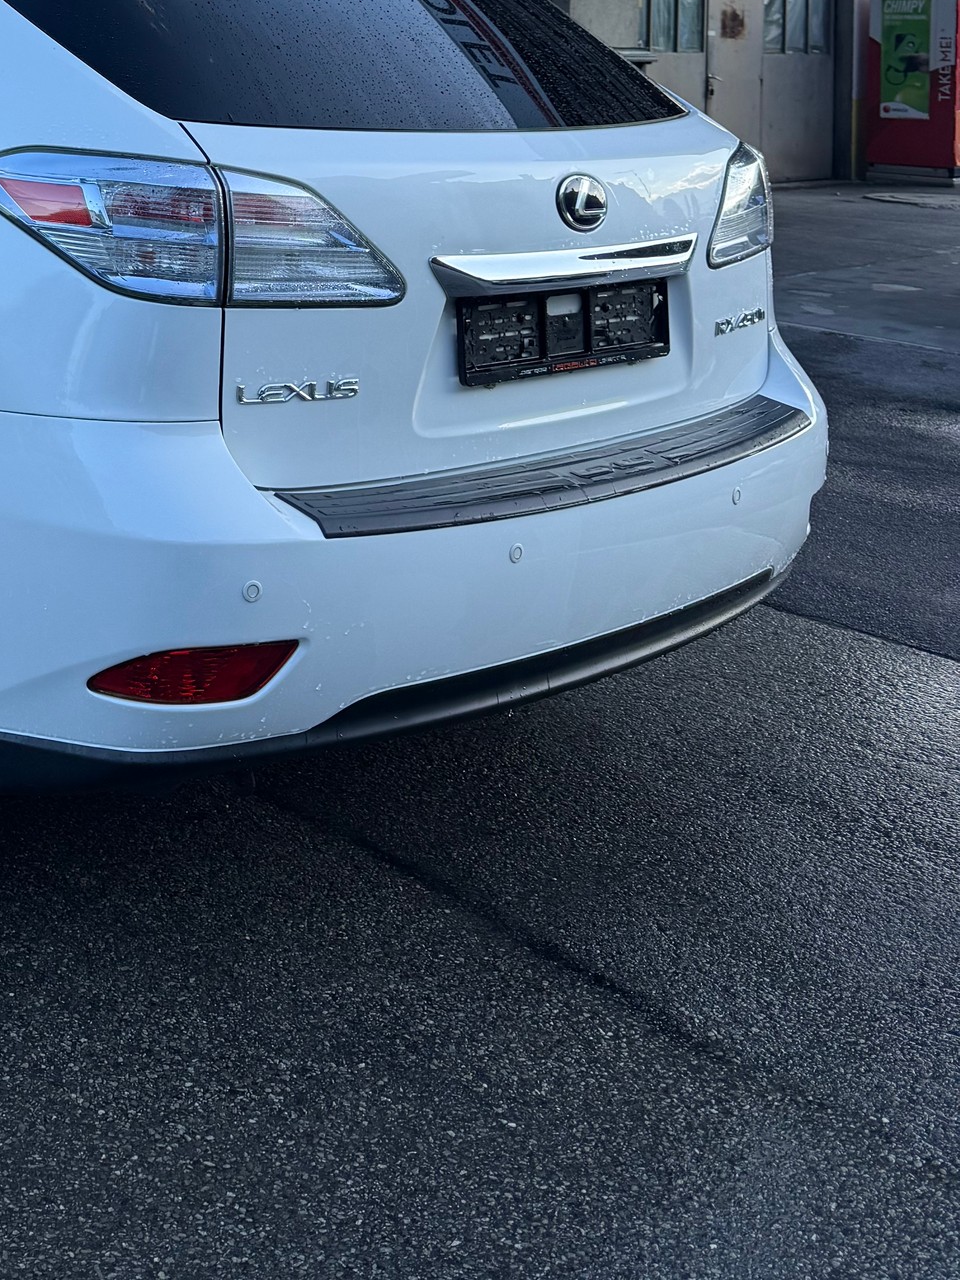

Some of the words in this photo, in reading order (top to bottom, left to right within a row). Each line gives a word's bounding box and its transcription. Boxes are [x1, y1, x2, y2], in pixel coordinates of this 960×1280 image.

[883, 0, 926, 13] CHIMPY
[939, 36, 952, 62] ME!
[937, 65, 951, 102] TAKE
[235, 378, 360, 405] LEXUS
